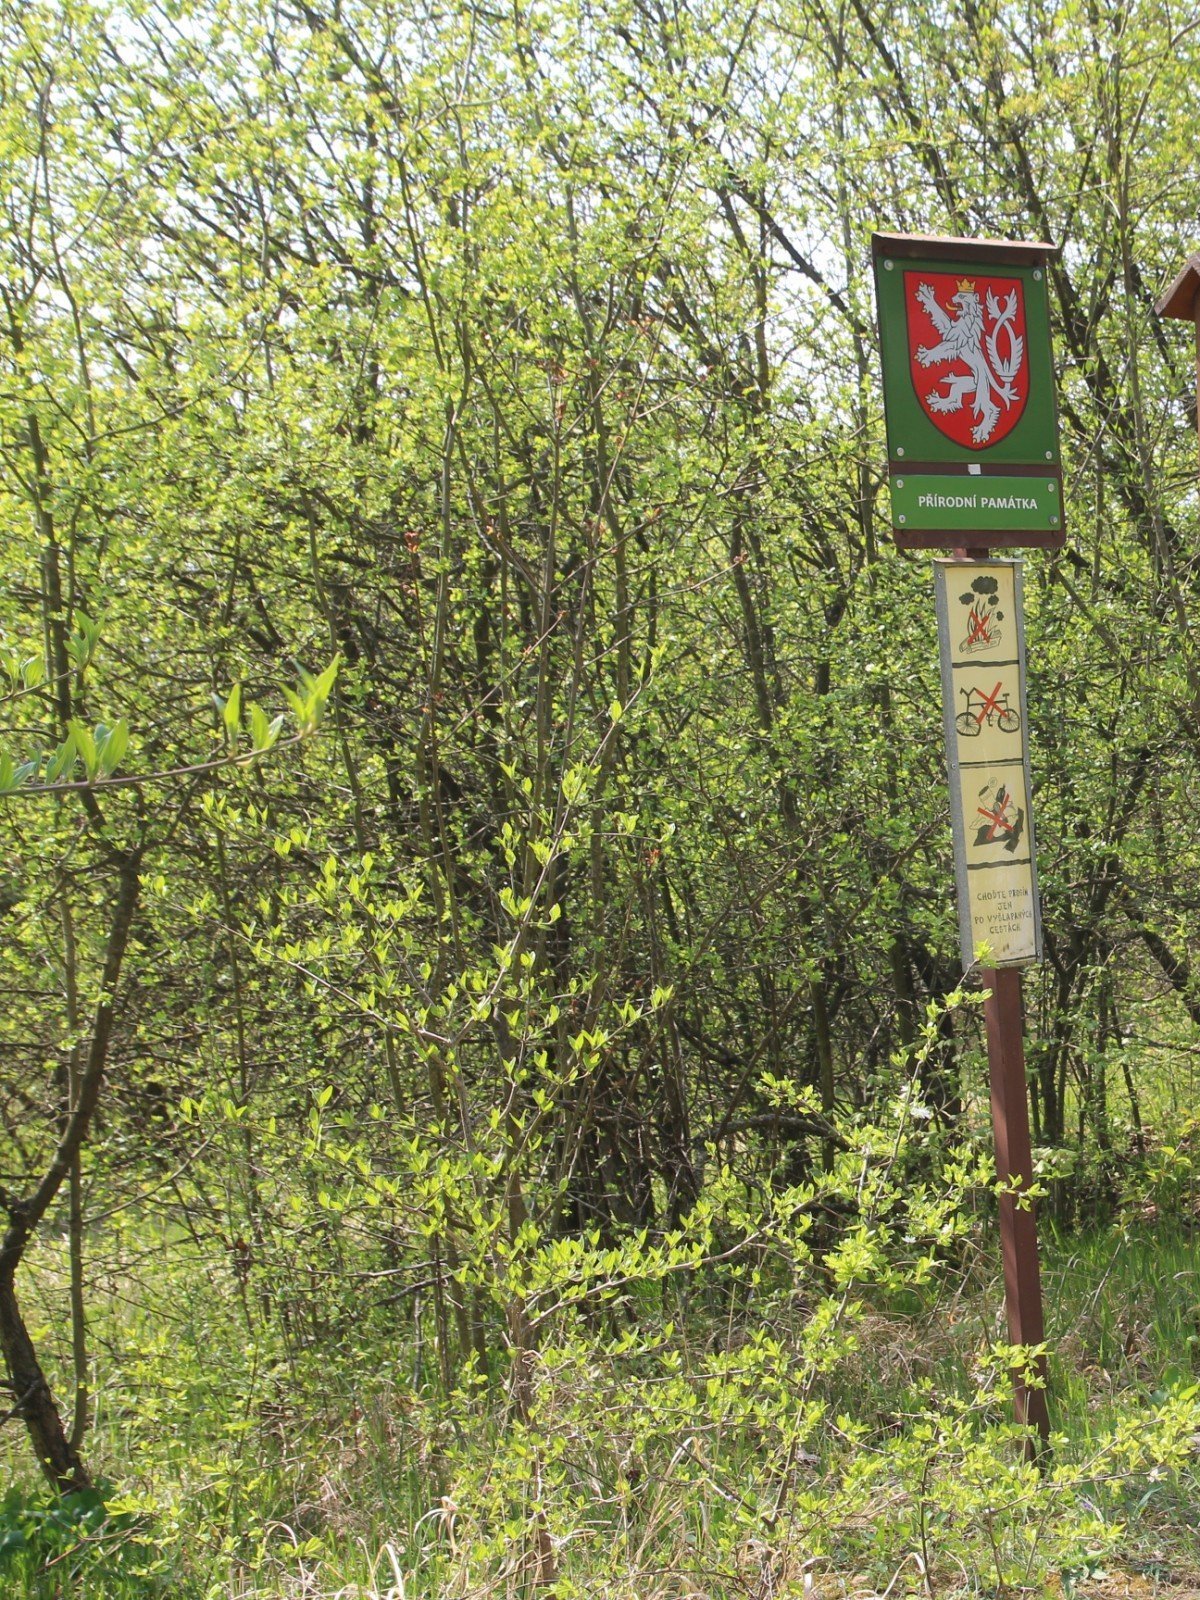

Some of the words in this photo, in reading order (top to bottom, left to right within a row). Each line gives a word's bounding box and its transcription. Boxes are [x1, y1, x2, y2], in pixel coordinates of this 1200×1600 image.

[918, 493, 977, 508] PŘÍRODNÍ
[981, 495, 1038, 509] PAMÁTKA
[974, 916, 984, 925] PO
